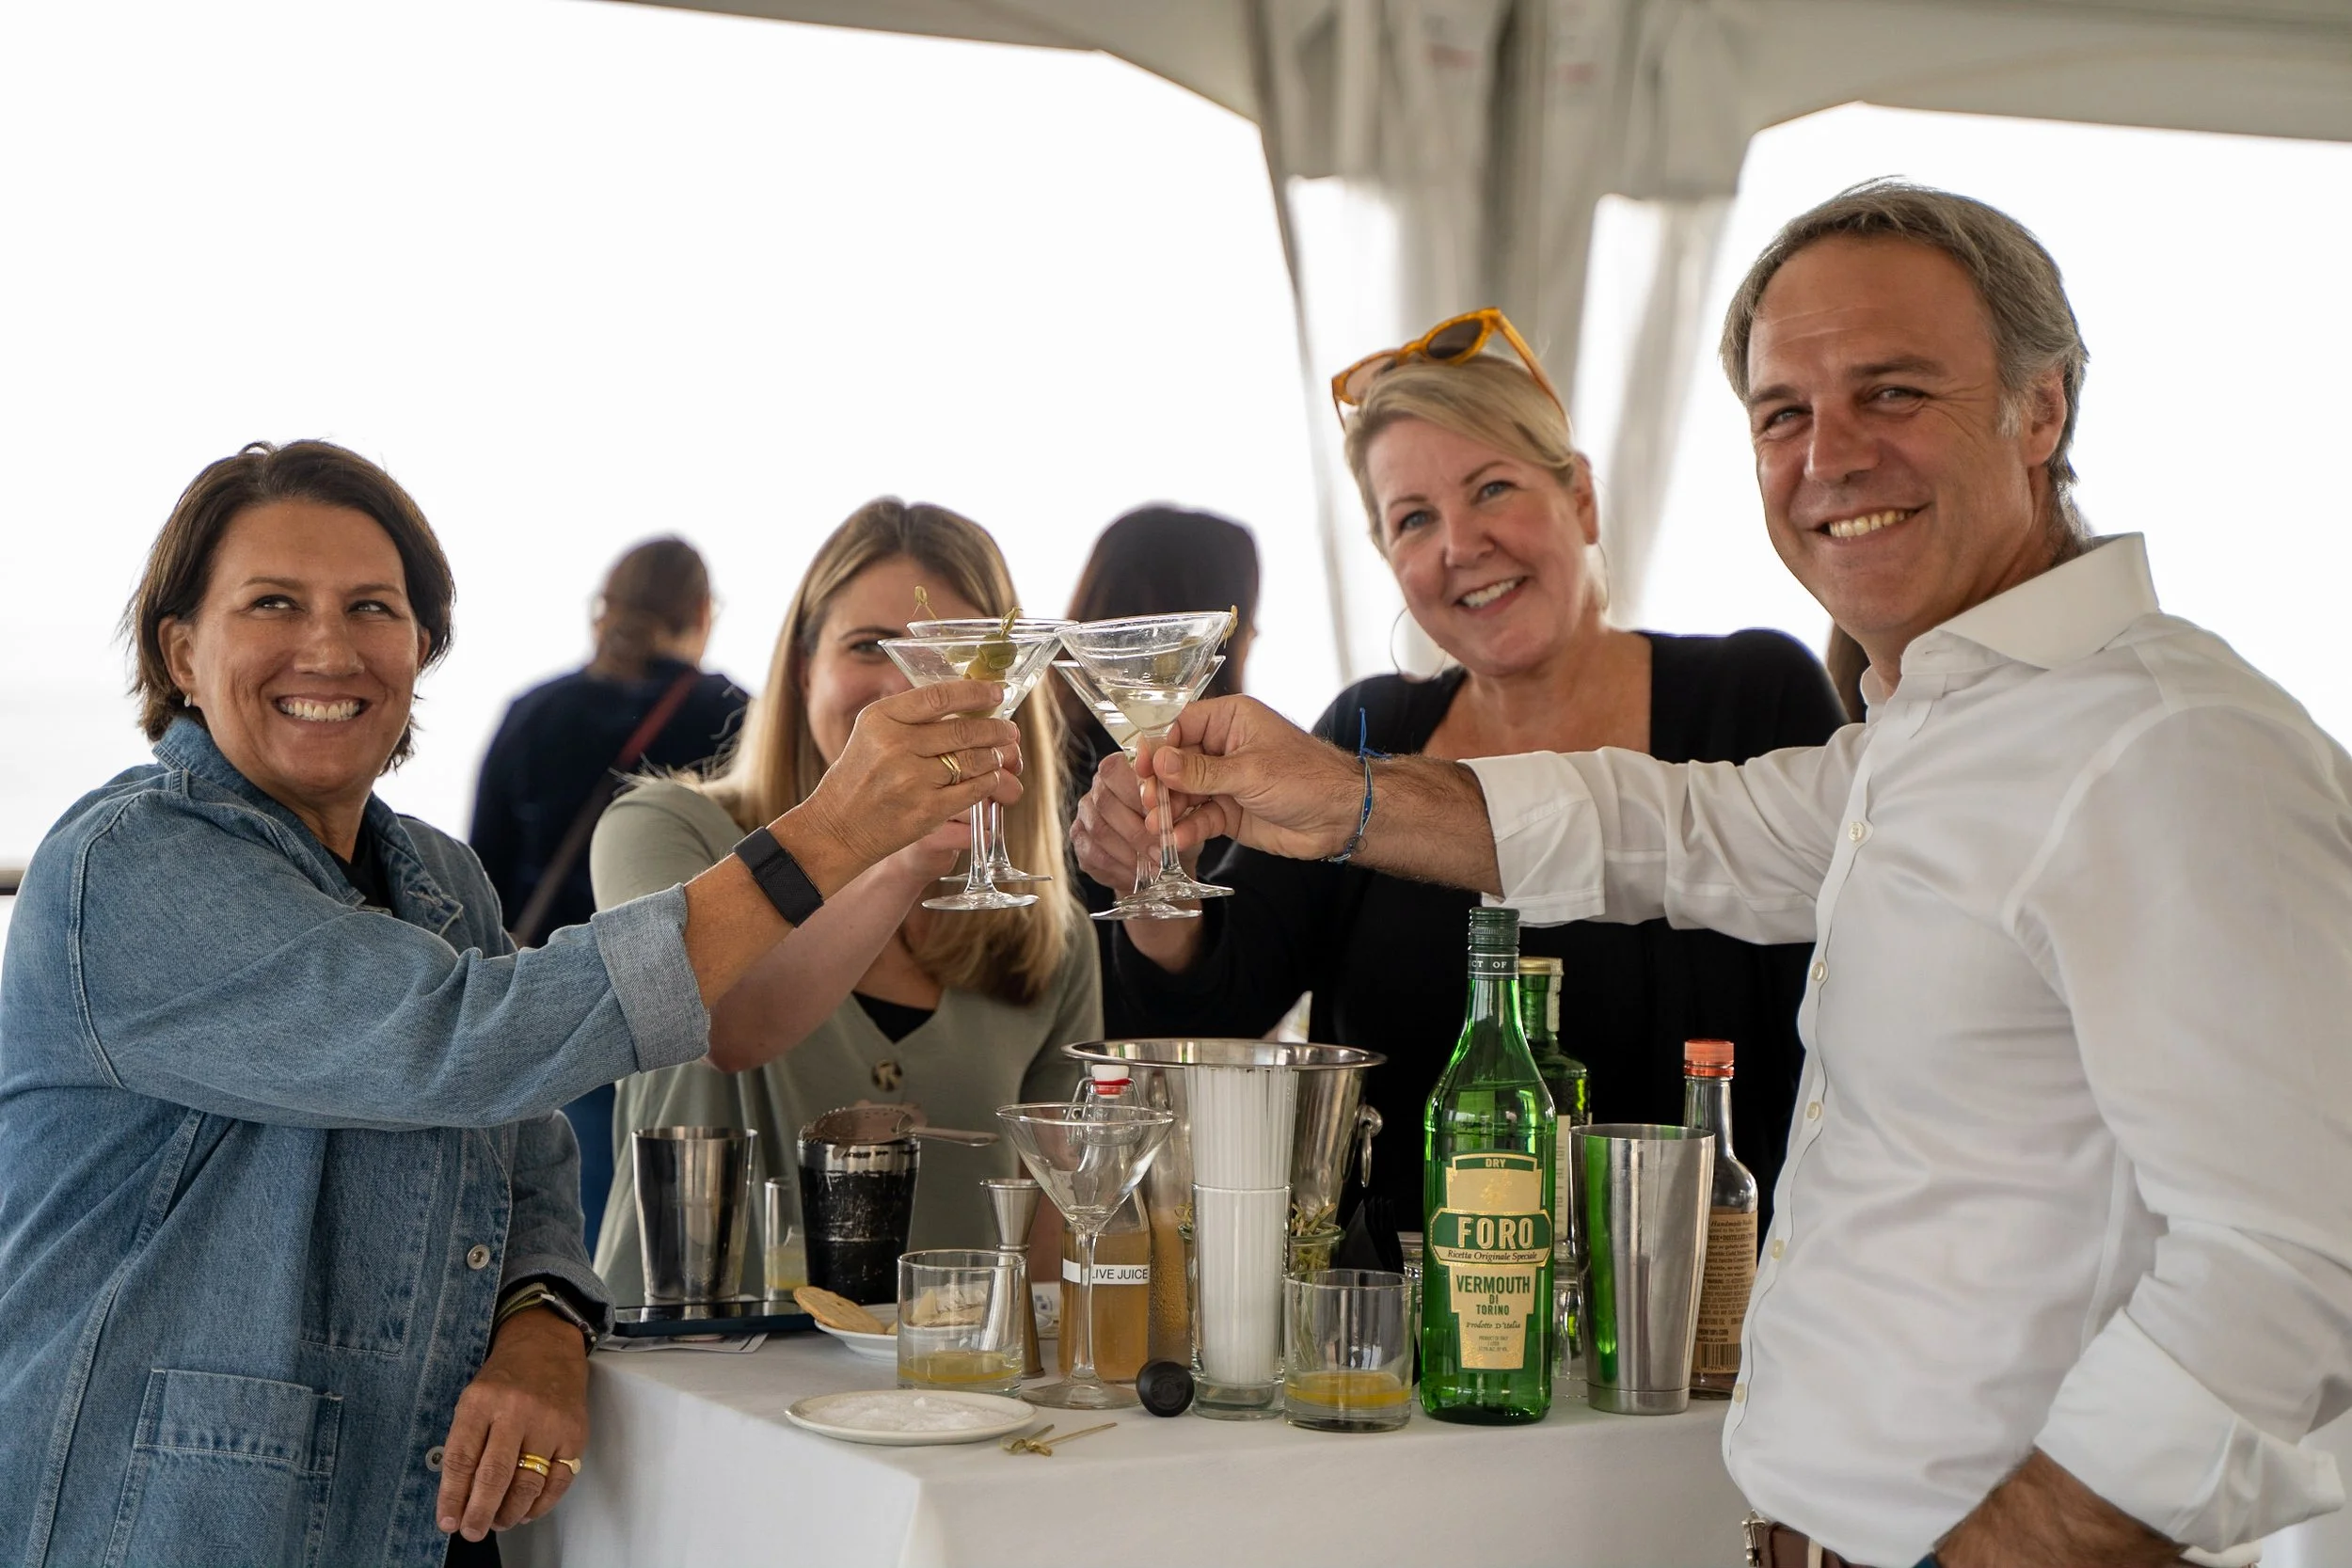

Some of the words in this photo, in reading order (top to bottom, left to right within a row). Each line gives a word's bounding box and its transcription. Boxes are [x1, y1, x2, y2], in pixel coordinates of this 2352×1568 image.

[1486, 1158, 1506, 1168] DRY
[1457, 1216, 1534, 1250] FORO
[1448, 1250, 1472, 1259] Ricetta
[1473, 1251, 1510, 1261] Originale
[1512, 1252, 1537, 1261] Speciale
[1117, 1269, 1149, 1279] JUICE
[1456, 1275, 1531, 1294] VERMOUTH
[1488, 1294, 1499, 1305] DI
[1476, 1305, 1510, 1315] TORINO
[1466, 1320, 1493, 1329] Prodotto
